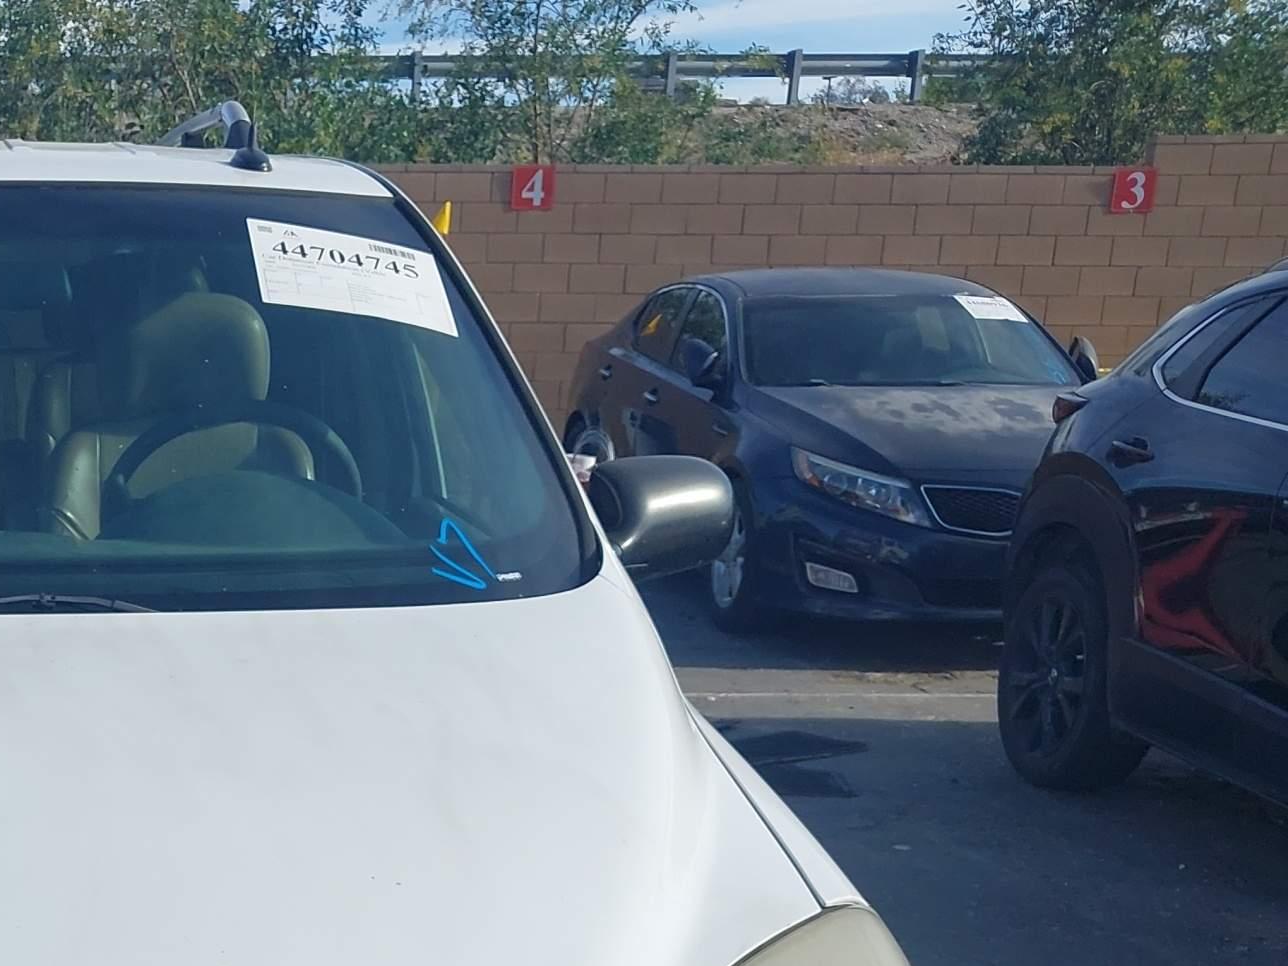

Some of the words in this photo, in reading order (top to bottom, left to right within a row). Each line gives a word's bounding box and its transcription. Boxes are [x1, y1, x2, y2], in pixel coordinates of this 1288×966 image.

[521, 168, 544, 206] 4
[1121, 171, 1146, 209] 3
[272, 241, 420, 280] 44704745
